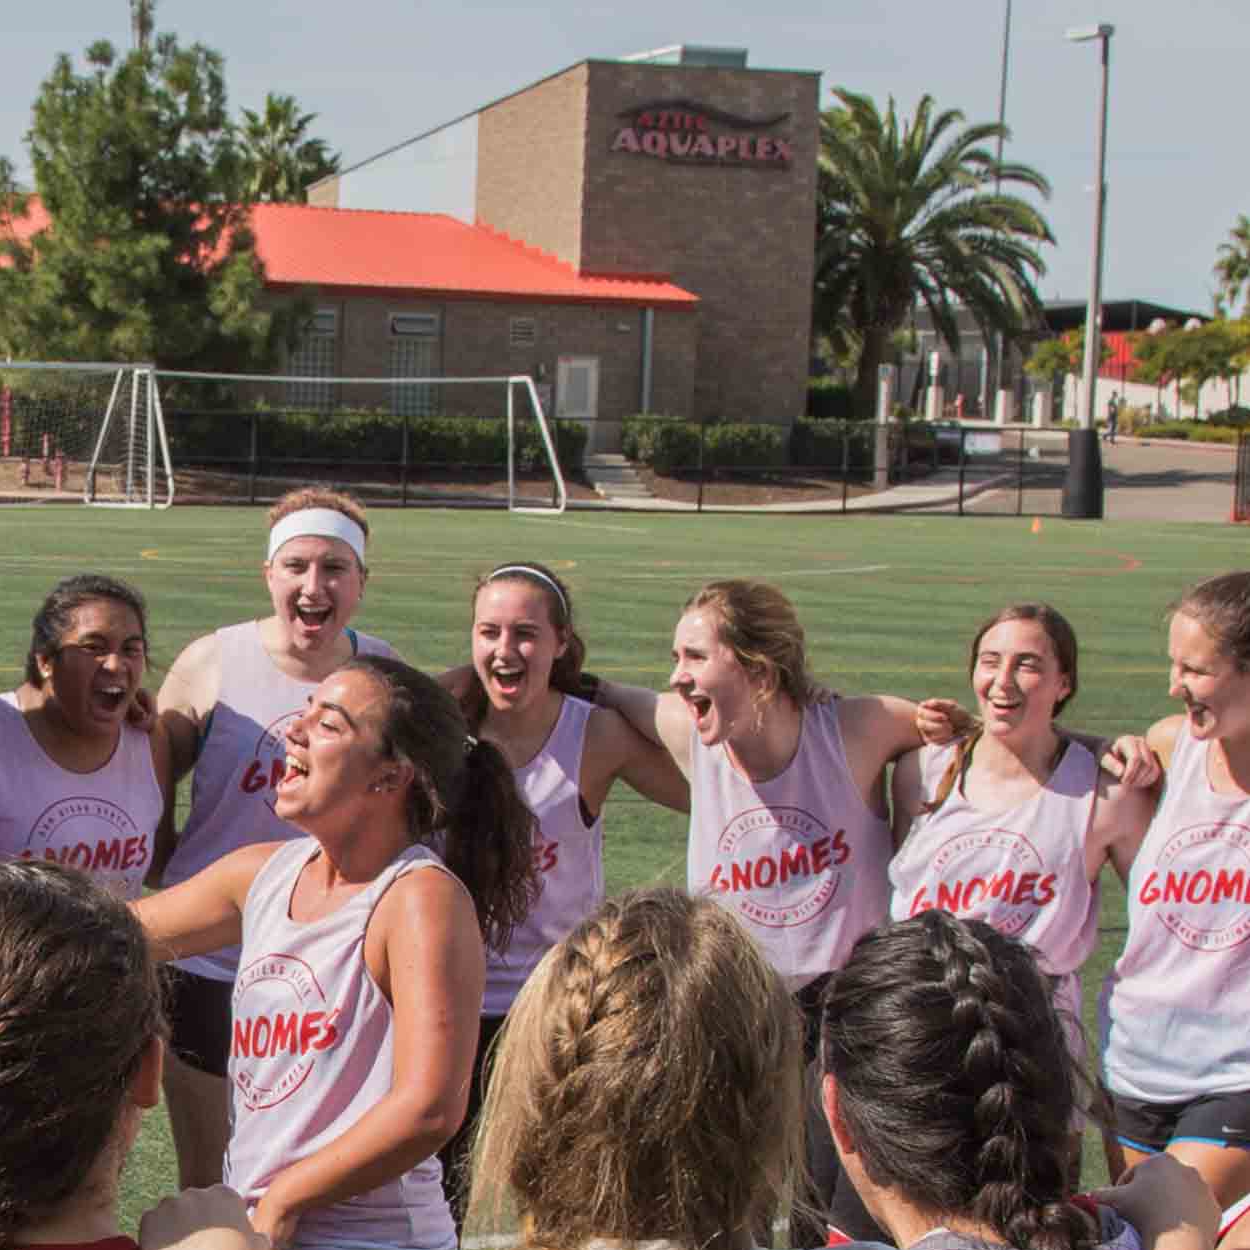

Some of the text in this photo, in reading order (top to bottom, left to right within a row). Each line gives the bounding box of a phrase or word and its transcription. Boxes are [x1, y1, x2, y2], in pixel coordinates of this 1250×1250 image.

[611, 127, 792, 161] AQUAPLEX
[711, 829, 851, 892] GNOMES
[910, 869, 1057, 917] GNOMES
[1139, 868, 1250, 904] GNOM
